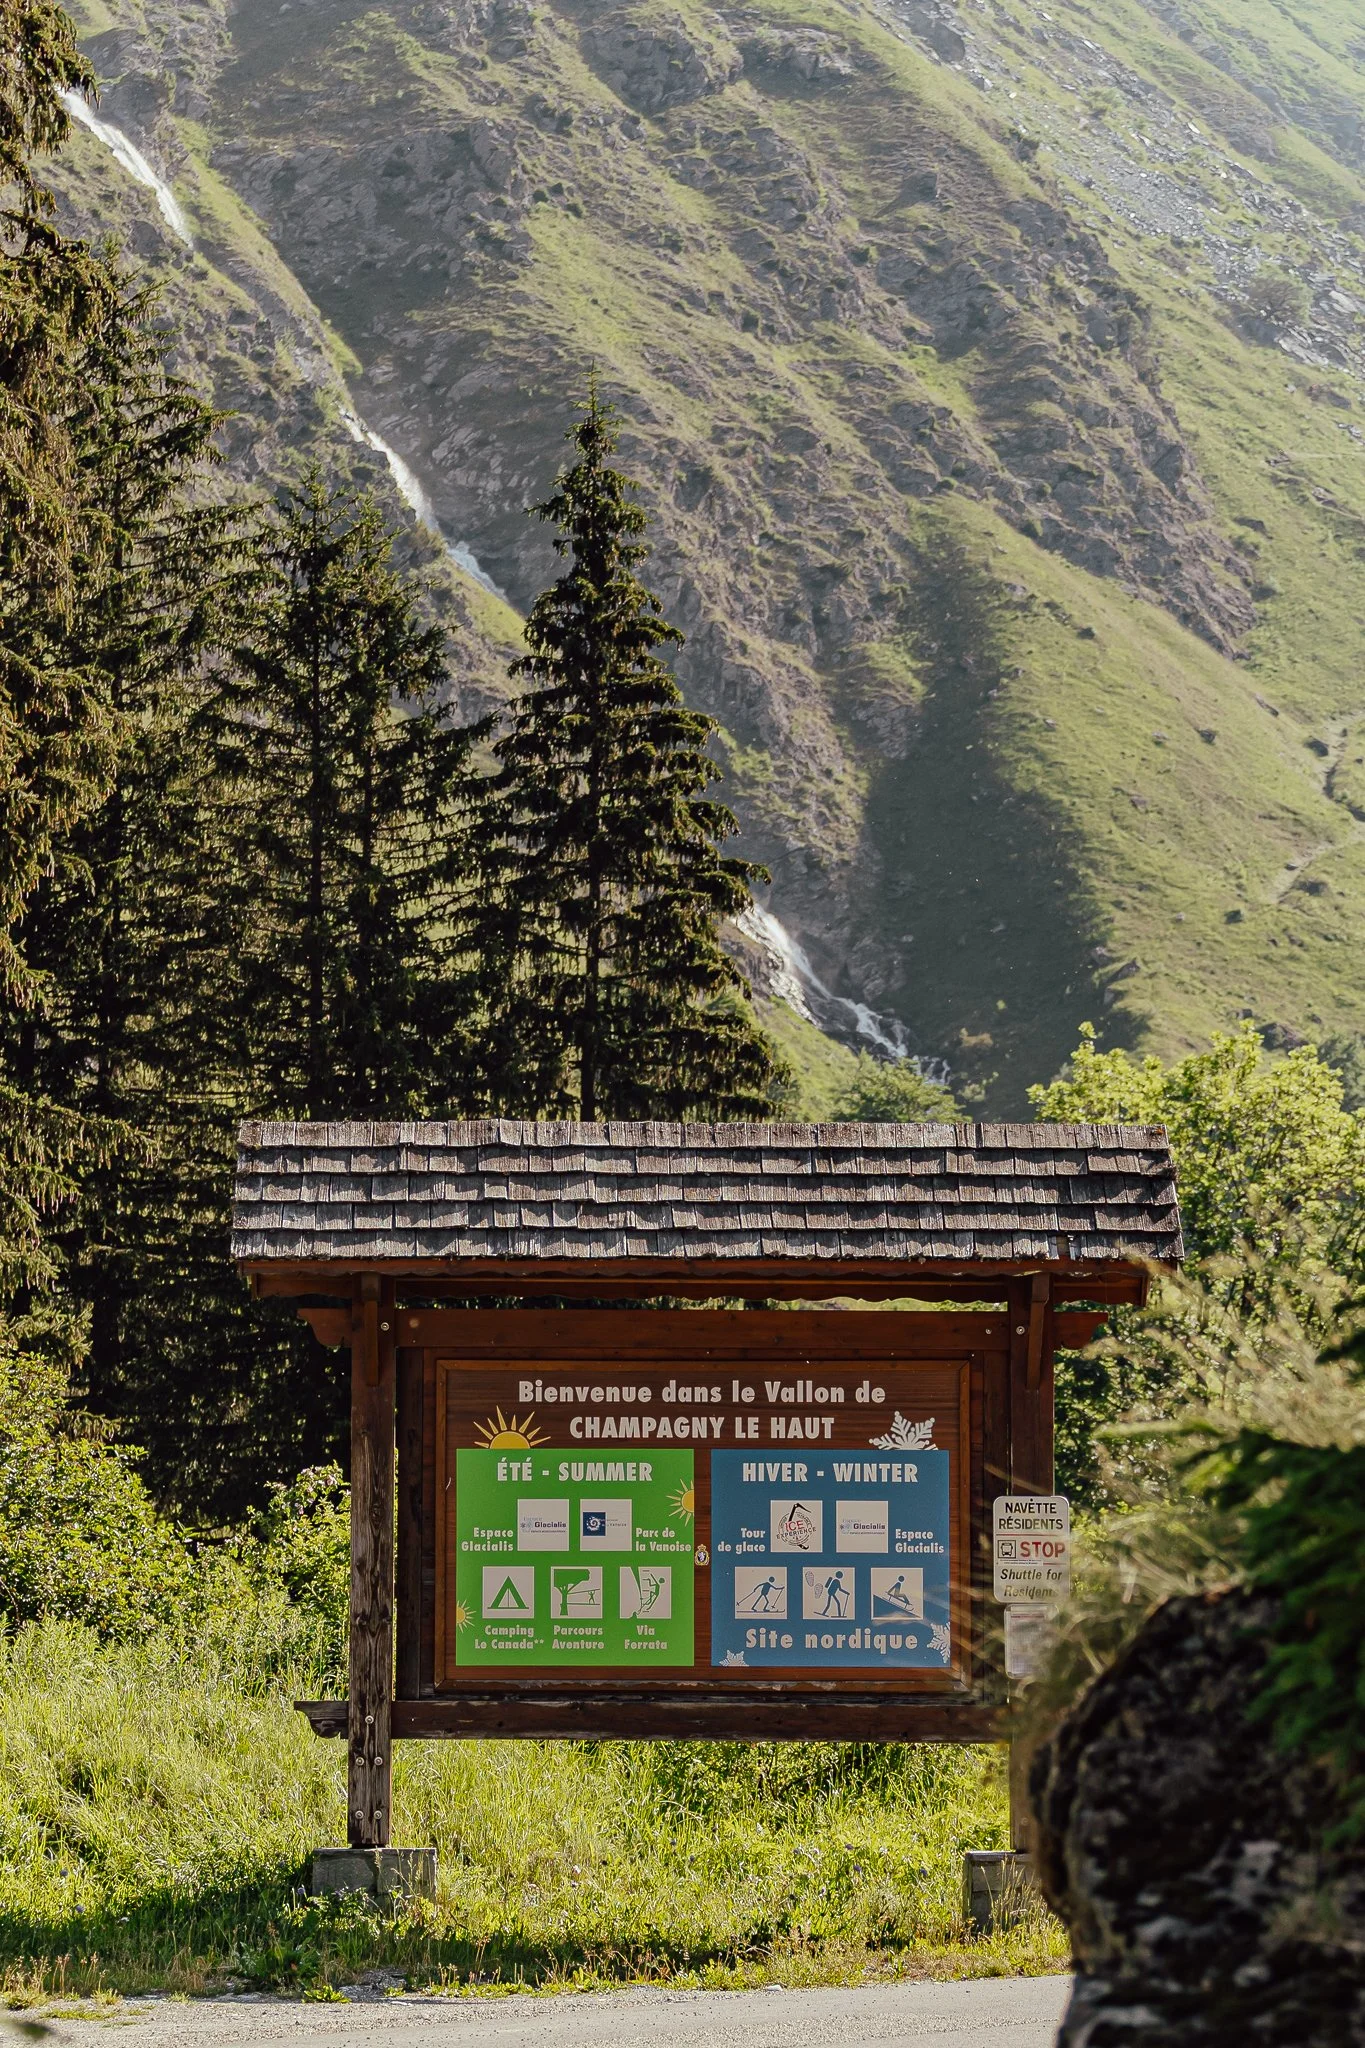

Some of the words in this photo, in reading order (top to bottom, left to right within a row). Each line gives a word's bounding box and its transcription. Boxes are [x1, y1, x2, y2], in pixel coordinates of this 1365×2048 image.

[518, 1379, 652, 1403] Bienvenue
[661, 1379, 723, 1403] dans
[732, 1379, 756, 1403] le
[765, 1379, 846, 1403] Vallon
[855, 1379, 886, 1403] de
[569, 1416, 726, 1439] CHAMPAGNY
[734, 1416, 760, 1439] LE
[770, 1416, 835, 1439] HAUT
[497, 1456, 533, 1482] ÉTÉ
[558, 1462, 653, 1482] SUMMER
[742, 1462, 808, 1482] HIVER
[833, 1462, 919, 1483] WINTER
[1005, 1502, 1057, 1514] NAVETTE
[534, 1521, 567, 1529] Glacialis
[785, 1520, 805, 1533] ICE
[853, 1522, 886, 1531] Glacialis
[998, 1516, 1064, 1530] RÉSIDENTS
[473, 1527, 514, 1539] Espace
[635, 1527, 660, 1538] Parc
[662, 1527, 676, 1538] de
[740, 1527, 766, 1539] Tour
[776, 1526, 817, 1540] EXPERIENCE
[895, 1529, 934, 1540] Espace
[461, 1541, 514, 1552] Glacialis
[635, 1541, 648, 1552] la
[649, 1541, 692, 1552] Vanoise
[717, 1541, 732, 1552] de
[735, 1541, 766, 1555] glace
[895, 1542, 945, 1553] Glacialis
[1020, 1541, 1066, 1558] STOP
[1000, 1568, 1042, 1580] Shuttle
[1046, 1568, 1063, 1580] for
[484, 1625, 535, 1637] Camping
[553, 1625, 604, 1635] Parcours
[636, 1625, 656, 1635] Via
[474, 1639, 487, 1649] Le
[552, 1639, 605, 1649] Aventure
[624, 1639, 668, 1649] Ferrata
[745, 1627, 793, 1649] Site
[805, 1627, 918, 1655] nordique
